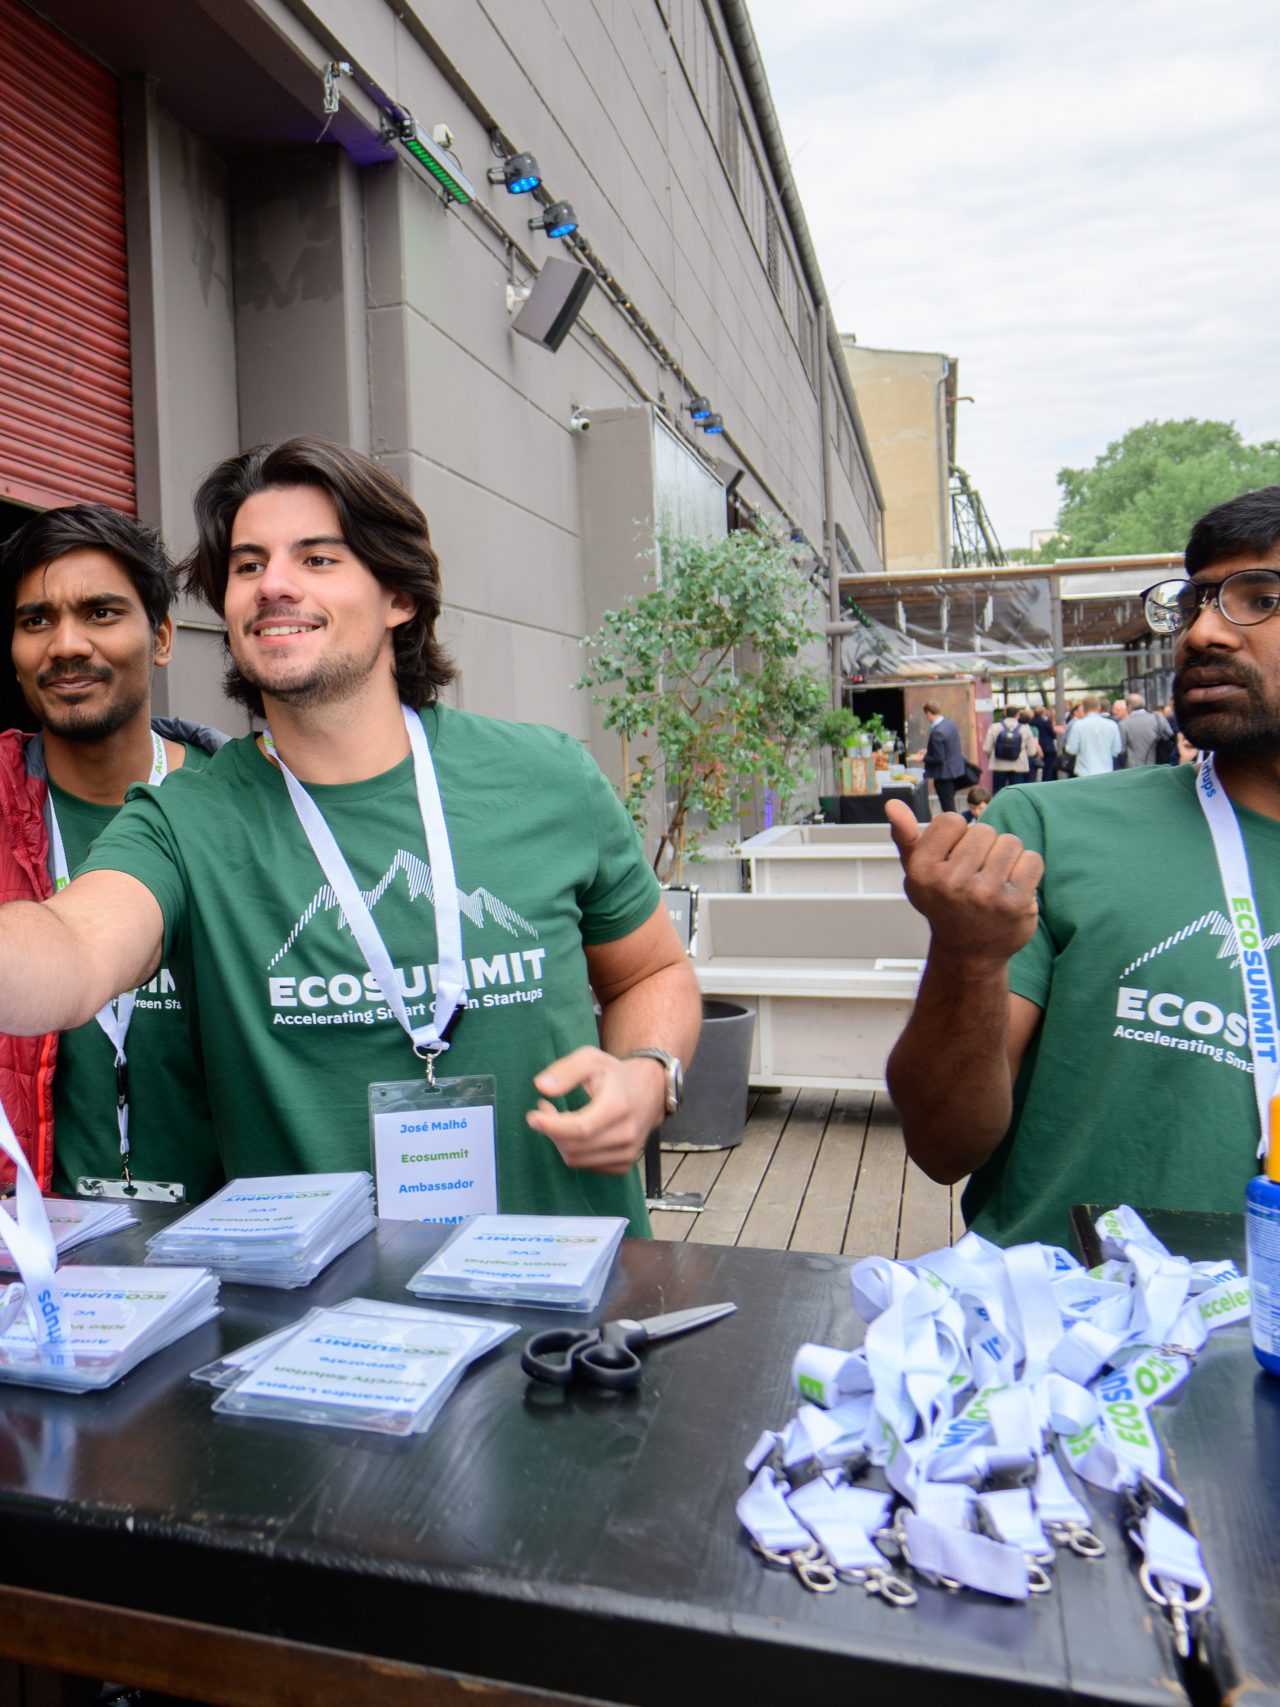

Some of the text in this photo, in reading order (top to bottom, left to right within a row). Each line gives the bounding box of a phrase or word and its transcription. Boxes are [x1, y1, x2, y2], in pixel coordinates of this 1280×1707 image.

[269, 948, 546, 1007] ECOSUMIT
[1231, 897, 1279, 1063] ECOSUMMIT
[273, 1009, 375, 1026] Accelerating
[483, 988, 543, 1008] Startups
[1113, 1025, 1225, 1062] Accelerating
[400, 1118, 468, 1134] José Malhó
[401, 1148, 470, 1163] Ecosummit
[399, 1179, 474, 1194] Ambassador
[222, 1192, 332, 1203] ECOSUMMIT
[472, 1235, 598, 1243] ECOSUMMIT
[61, 1292, 169, 1301] ECOSUMM
[309, 1336, 451, 1356] ECOSUMMIT
[319, 1356, 408, 1371] Corporate
[273, 1365, 349, 1381] Solution
[321, 1387, 417, 1403] Alexandra
